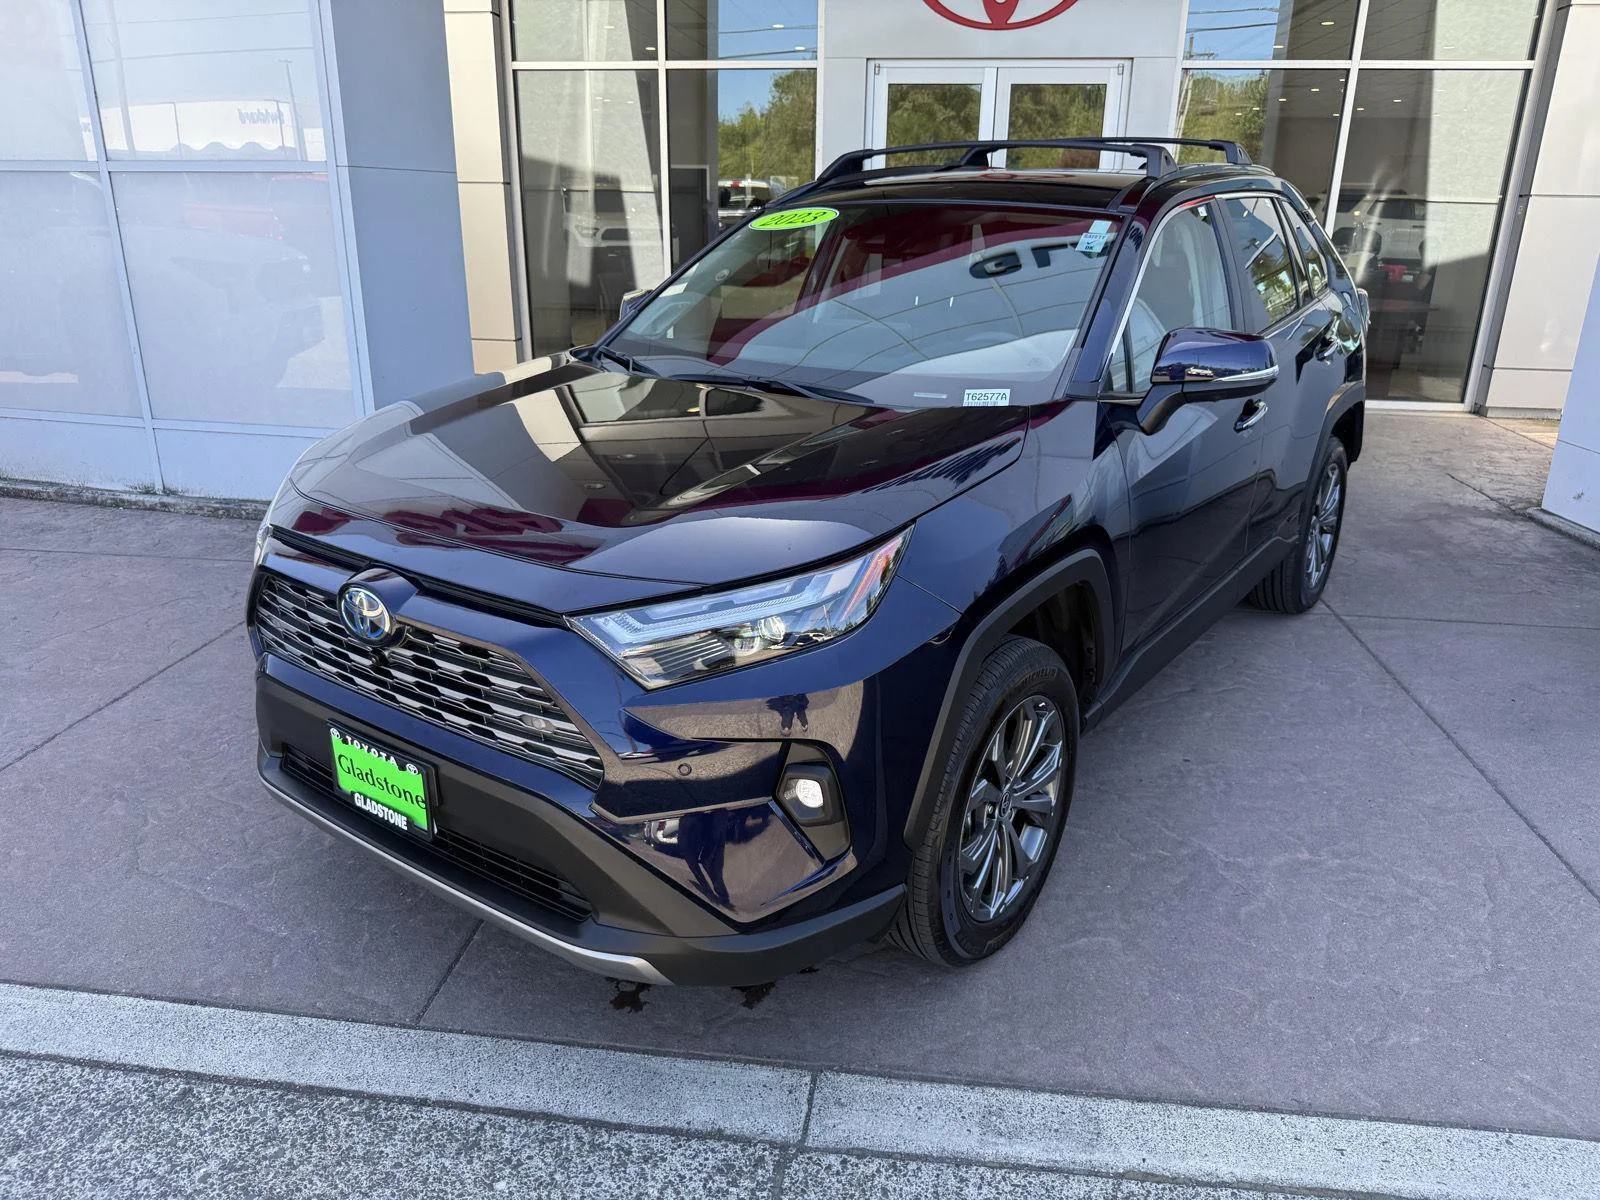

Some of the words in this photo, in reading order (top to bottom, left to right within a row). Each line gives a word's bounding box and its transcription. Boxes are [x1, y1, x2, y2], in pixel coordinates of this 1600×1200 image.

[966, 392, 1007, 401] T62577A
[345, 735, 399, 769] TOYOTA
[337, 754, 427, 809] Gladstone
[354, 792, 408, 831] GLADSTONE
